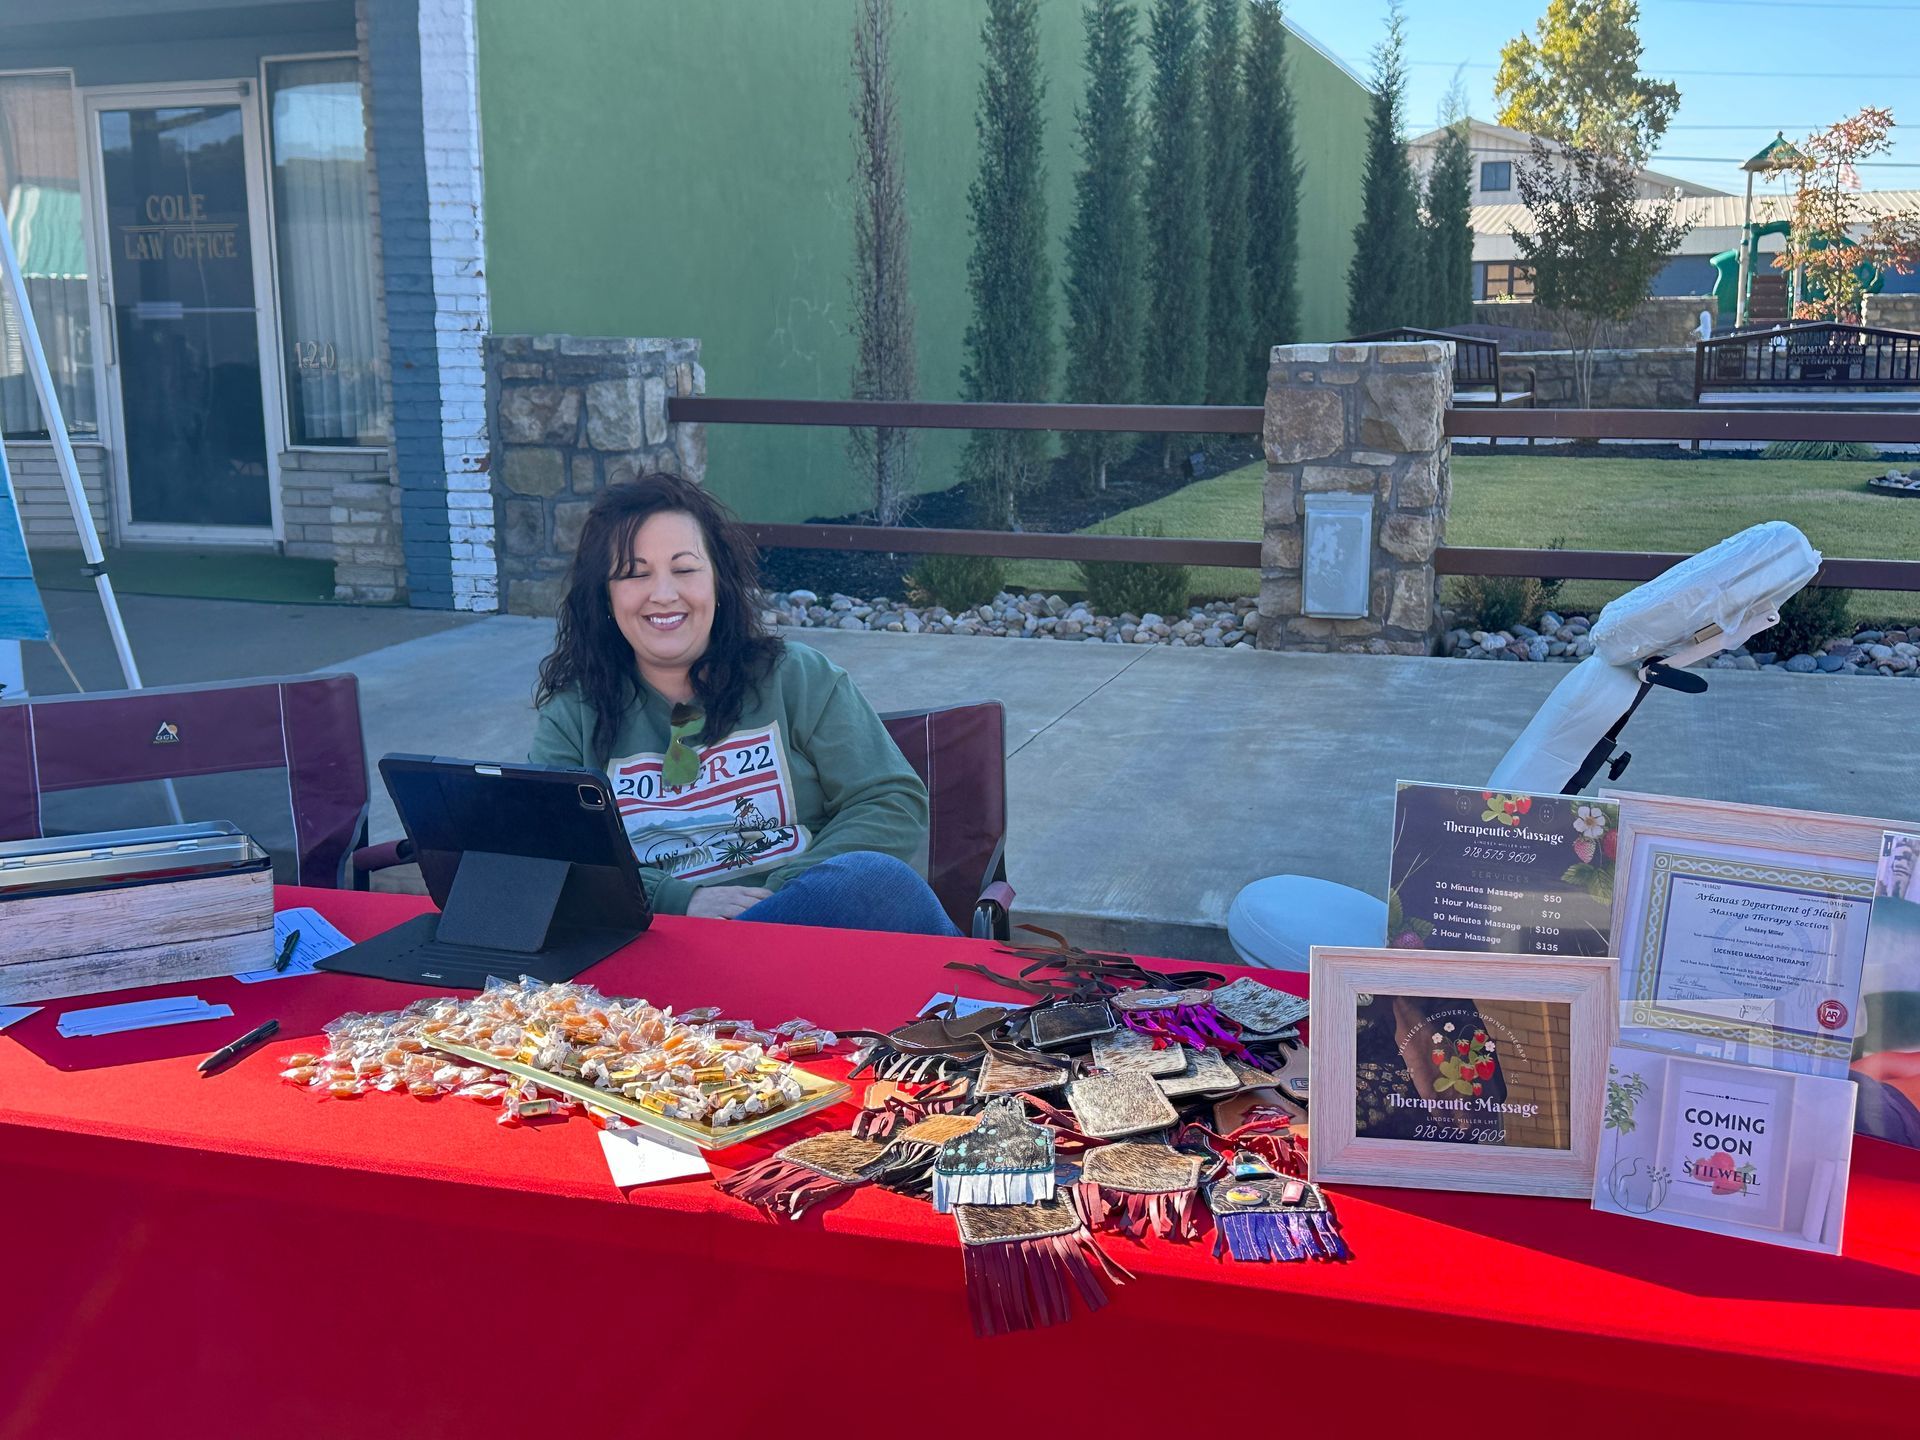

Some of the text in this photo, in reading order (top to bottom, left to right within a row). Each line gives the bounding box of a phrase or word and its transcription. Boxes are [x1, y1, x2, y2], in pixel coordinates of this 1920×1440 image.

[145, 194, 207, 223] COLE
[124, 232, 238, 260] LAW OFFICE
[295, 340, 337, 371] 120
[1443, 820, 1564, 846] Therapeutic Massage
[1462, 846, 1537, 864] 918 575 9609
[1471, 870, 1529, 883] SERVICES
[1435, 881, 1562, 904] 30 Minutes Massage $50
[1433, 896, 1561, 920] 1 Hour Massage $70
[1695, 892, 1739, 905] Arkansas
[1741, 898, 1799, 914] Department
[1801, 907, 1812, 918] of
[1812, 908, 1847, 920] Health
[1433, 912, 1559, 935] 90 Minutes Massage $100
[1709, 908, 1830, 931] Massage Therapy Section
[1431, 928, 1559, 952] 2 Hour Massage $135
[1713, 947, 1744, 958] LICENSED
[1775, 956, 1810, 967] THERAPIST
[1472, 1011, 1506, 1032] CUPPING
[1506, 1031, 1528, 1063] THERAPY
[1386, 1093, 1539, 1118] Therapeutic Massage
[1412, 1124, 1507, 1142] 918 575 9609
[1684, 1107, 1765, 1135] COMING
[1692, 1132, 1753, 1157] SOON
[1682, 1160, 1761, 1186] STILWELL
